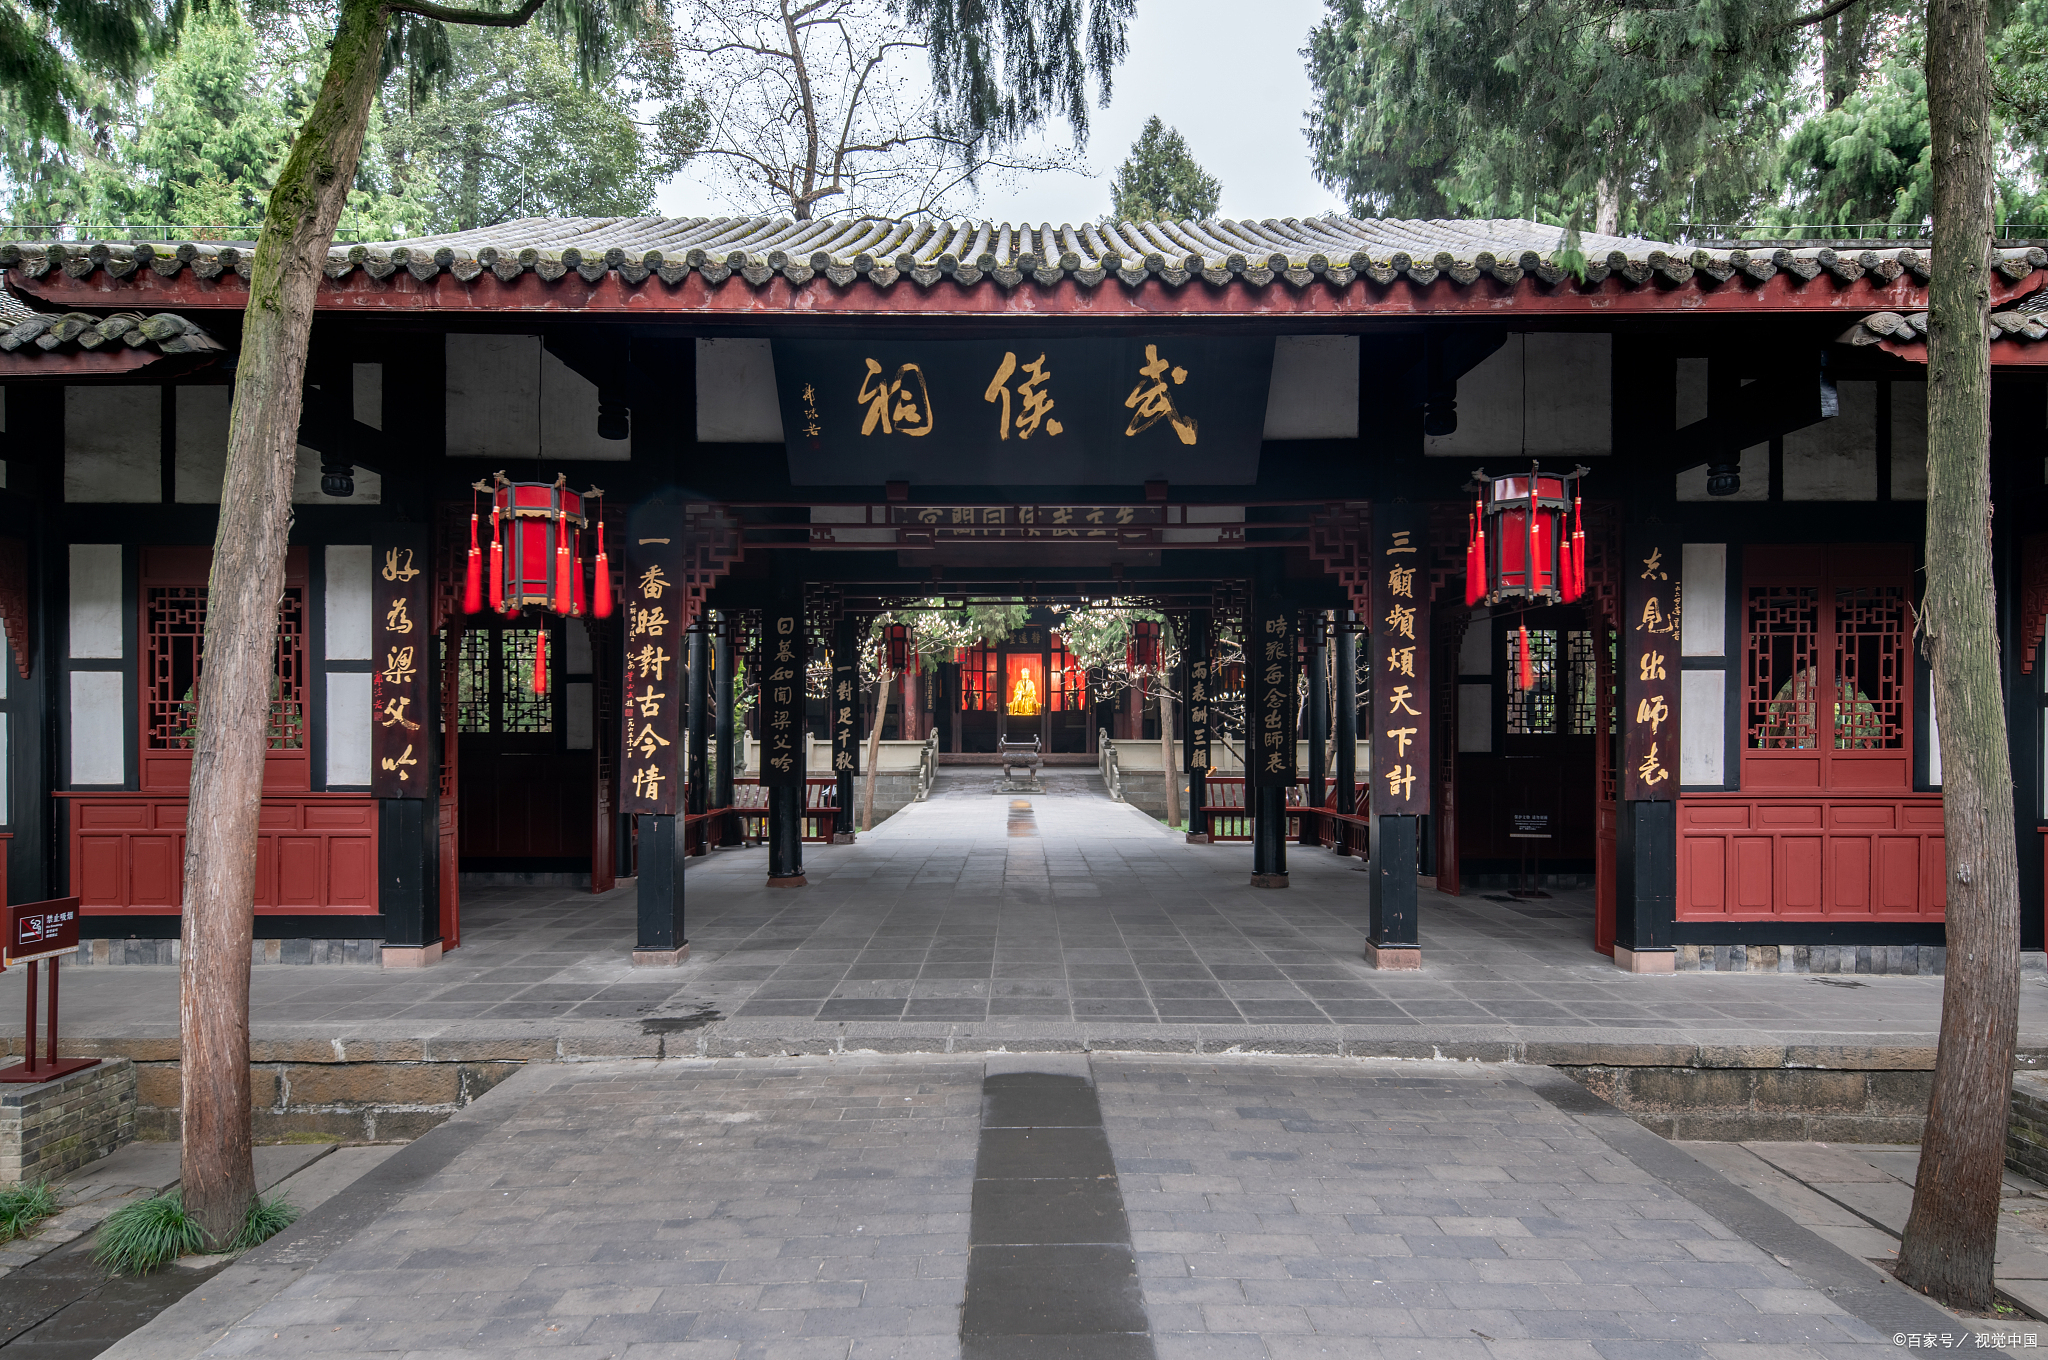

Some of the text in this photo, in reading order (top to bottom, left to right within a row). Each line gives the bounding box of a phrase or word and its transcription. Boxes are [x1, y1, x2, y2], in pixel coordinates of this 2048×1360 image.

[858, 344, 1197, 446] 武侯祠
[633, 538, 671, 800] 一番晤對古今情
[769, 617, 795, 773] 日暮如聞梁父吟
[836, 665, 854, 770] 一對足千秋
[1191, 661, 1208, 769] 兩表酬三顧
[1263, 614, 1288, 774] 時艱每念出師表
[1385, 531, 1421, 801] 三顧頻煩天下計
[46, 911, 73, 924] 禁止吸烟
